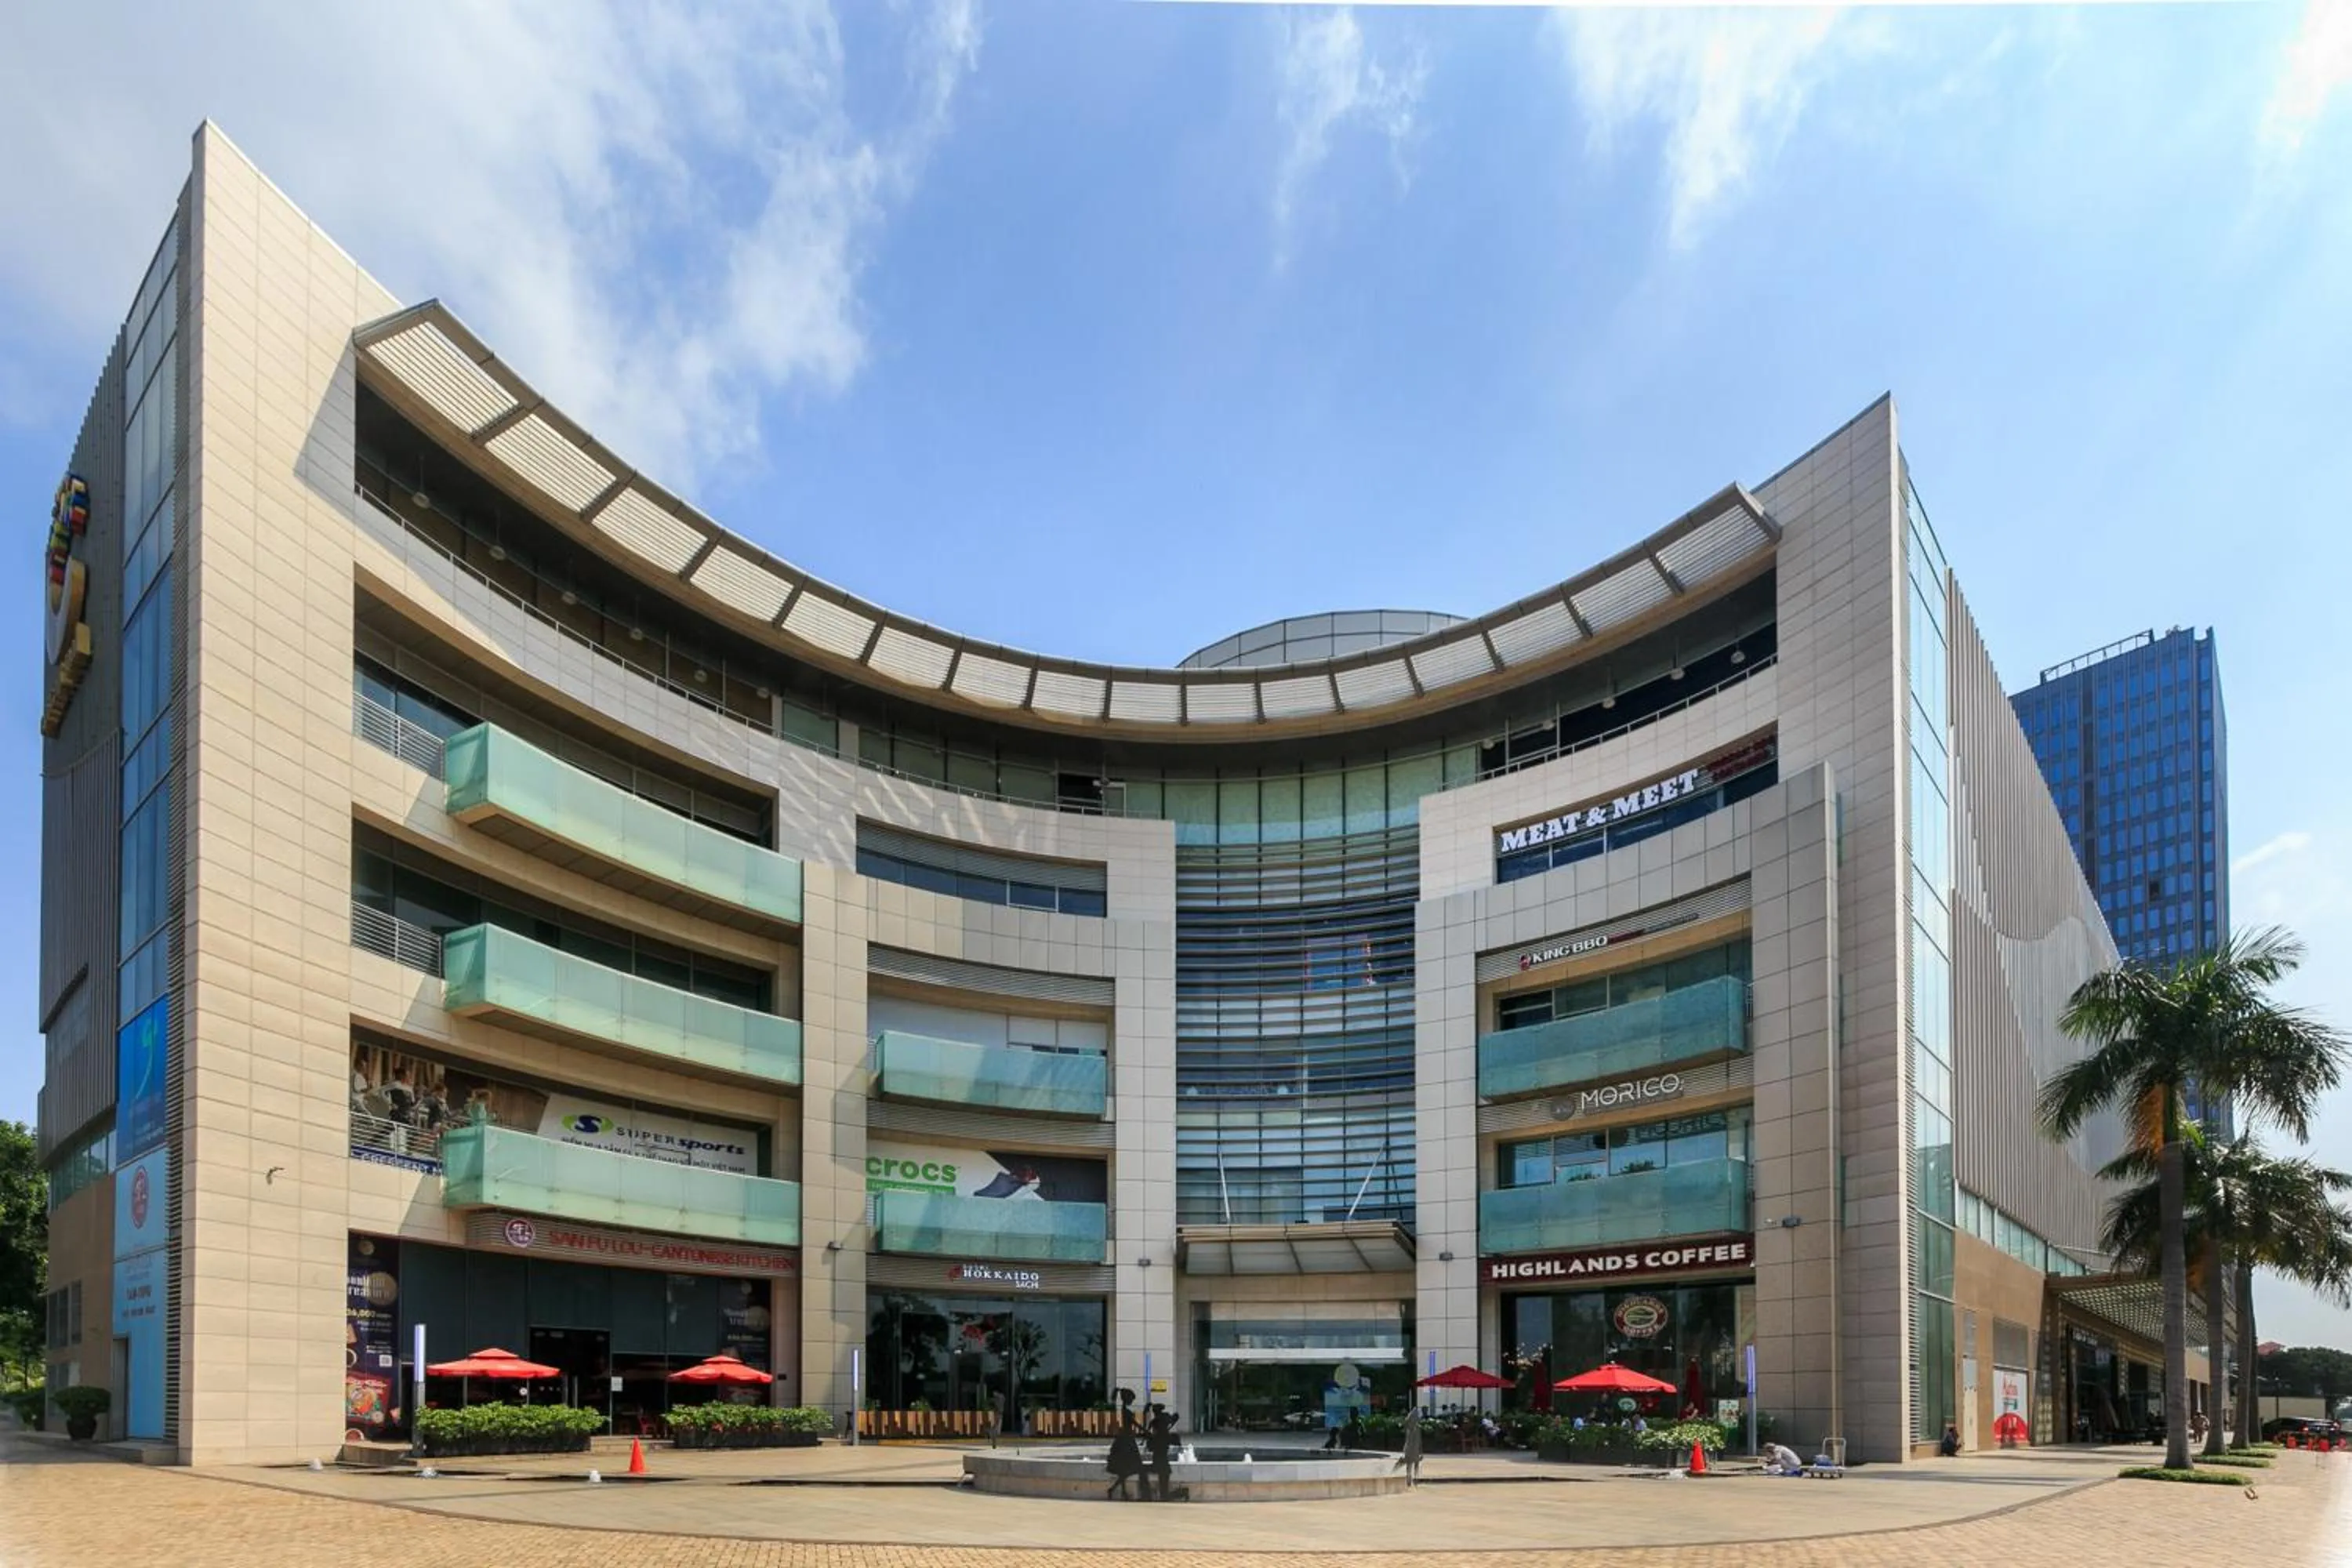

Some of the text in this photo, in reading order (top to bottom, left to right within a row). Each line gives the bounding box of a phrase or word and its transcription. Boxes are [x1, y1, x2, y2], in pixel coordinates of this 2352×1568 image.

[1501, 768, 1699, 852] MEAT & MEET
[1533, 945, 1570, 964] KING
[1581, 1073, 1680, 1111] MORICO
[865, 1156, 956, 1183] crocs
[963, 1269, 1040, 1281] HOKKAIDO
[1492, 1243, 1746, 1279] HIGHLANDS COFFEE
